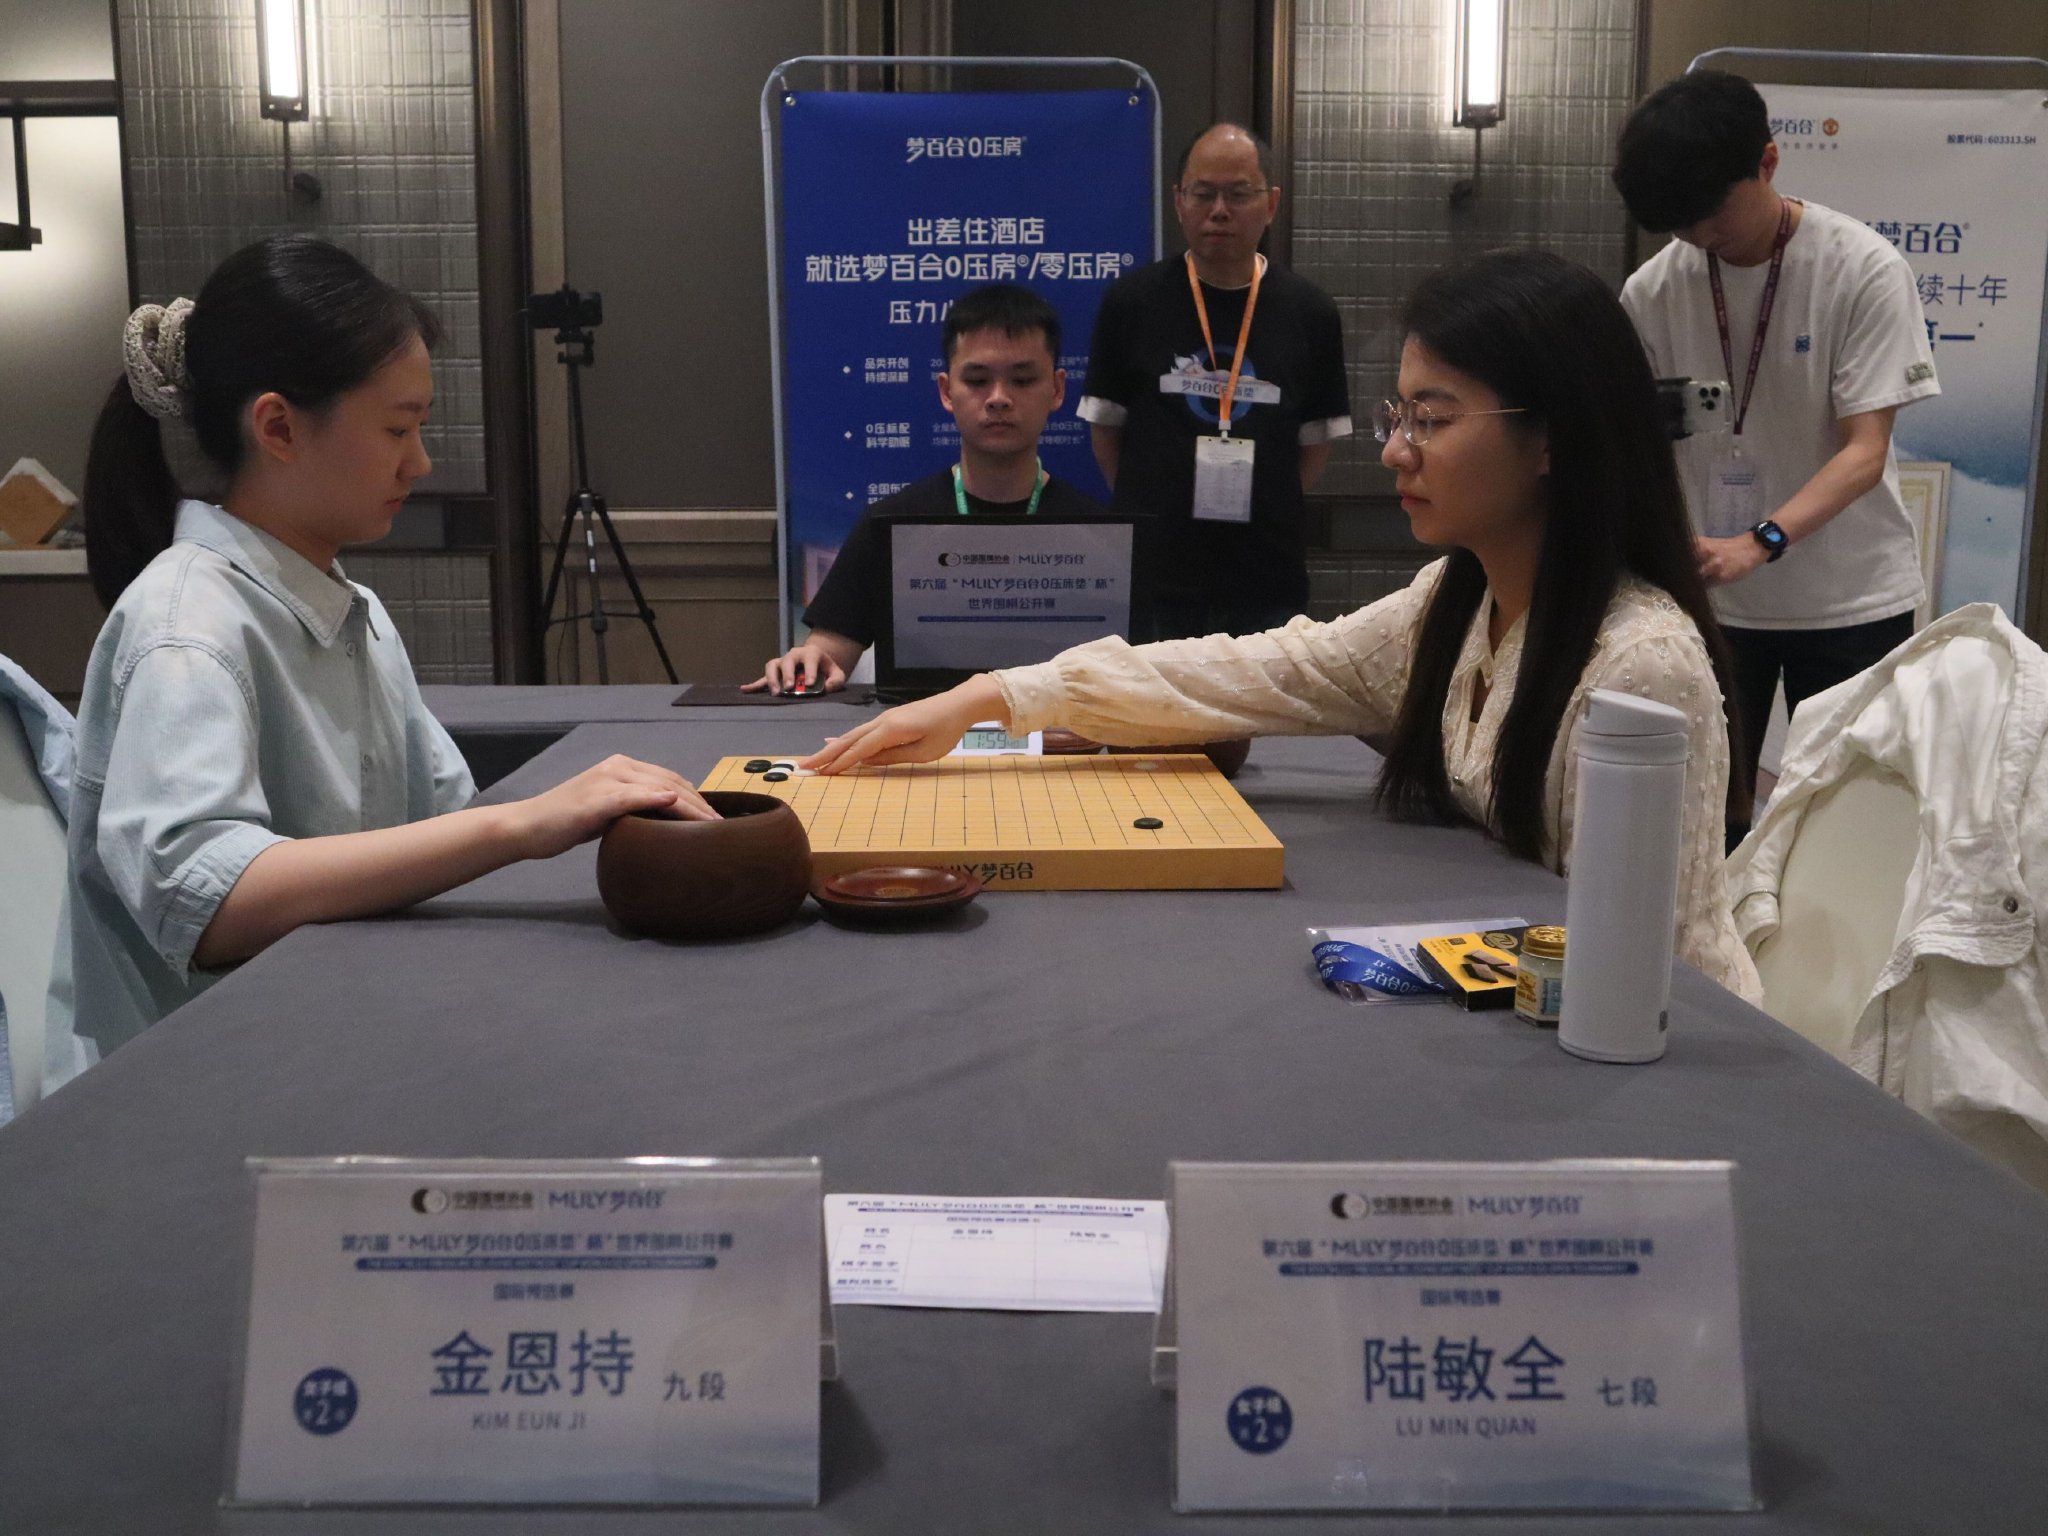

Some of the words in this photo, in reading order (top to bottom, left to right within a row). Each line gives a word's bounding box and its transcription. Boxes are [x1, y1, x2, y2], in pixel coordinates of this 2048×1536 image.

[907, 217, 1045, 245] 出差住酒店
[429, 1330, 635, 1397] 金恩持
[662, 1371, 726, 1402] 九段
[1364, 1335, 1566, 1403] 陆敏全
[1597, 1376, 1658, 1408] 七段
[473, 1412, 509, 1431] KIM
[516, 1412, 560, 1431] EUN
[568, 1412, 586, 1431] JI
[1396, 1417, 1423, 1436] LU
[1430, 1417, 1469, 1436] MIN
[1476, 1418, 1536, 1438] QUAN
